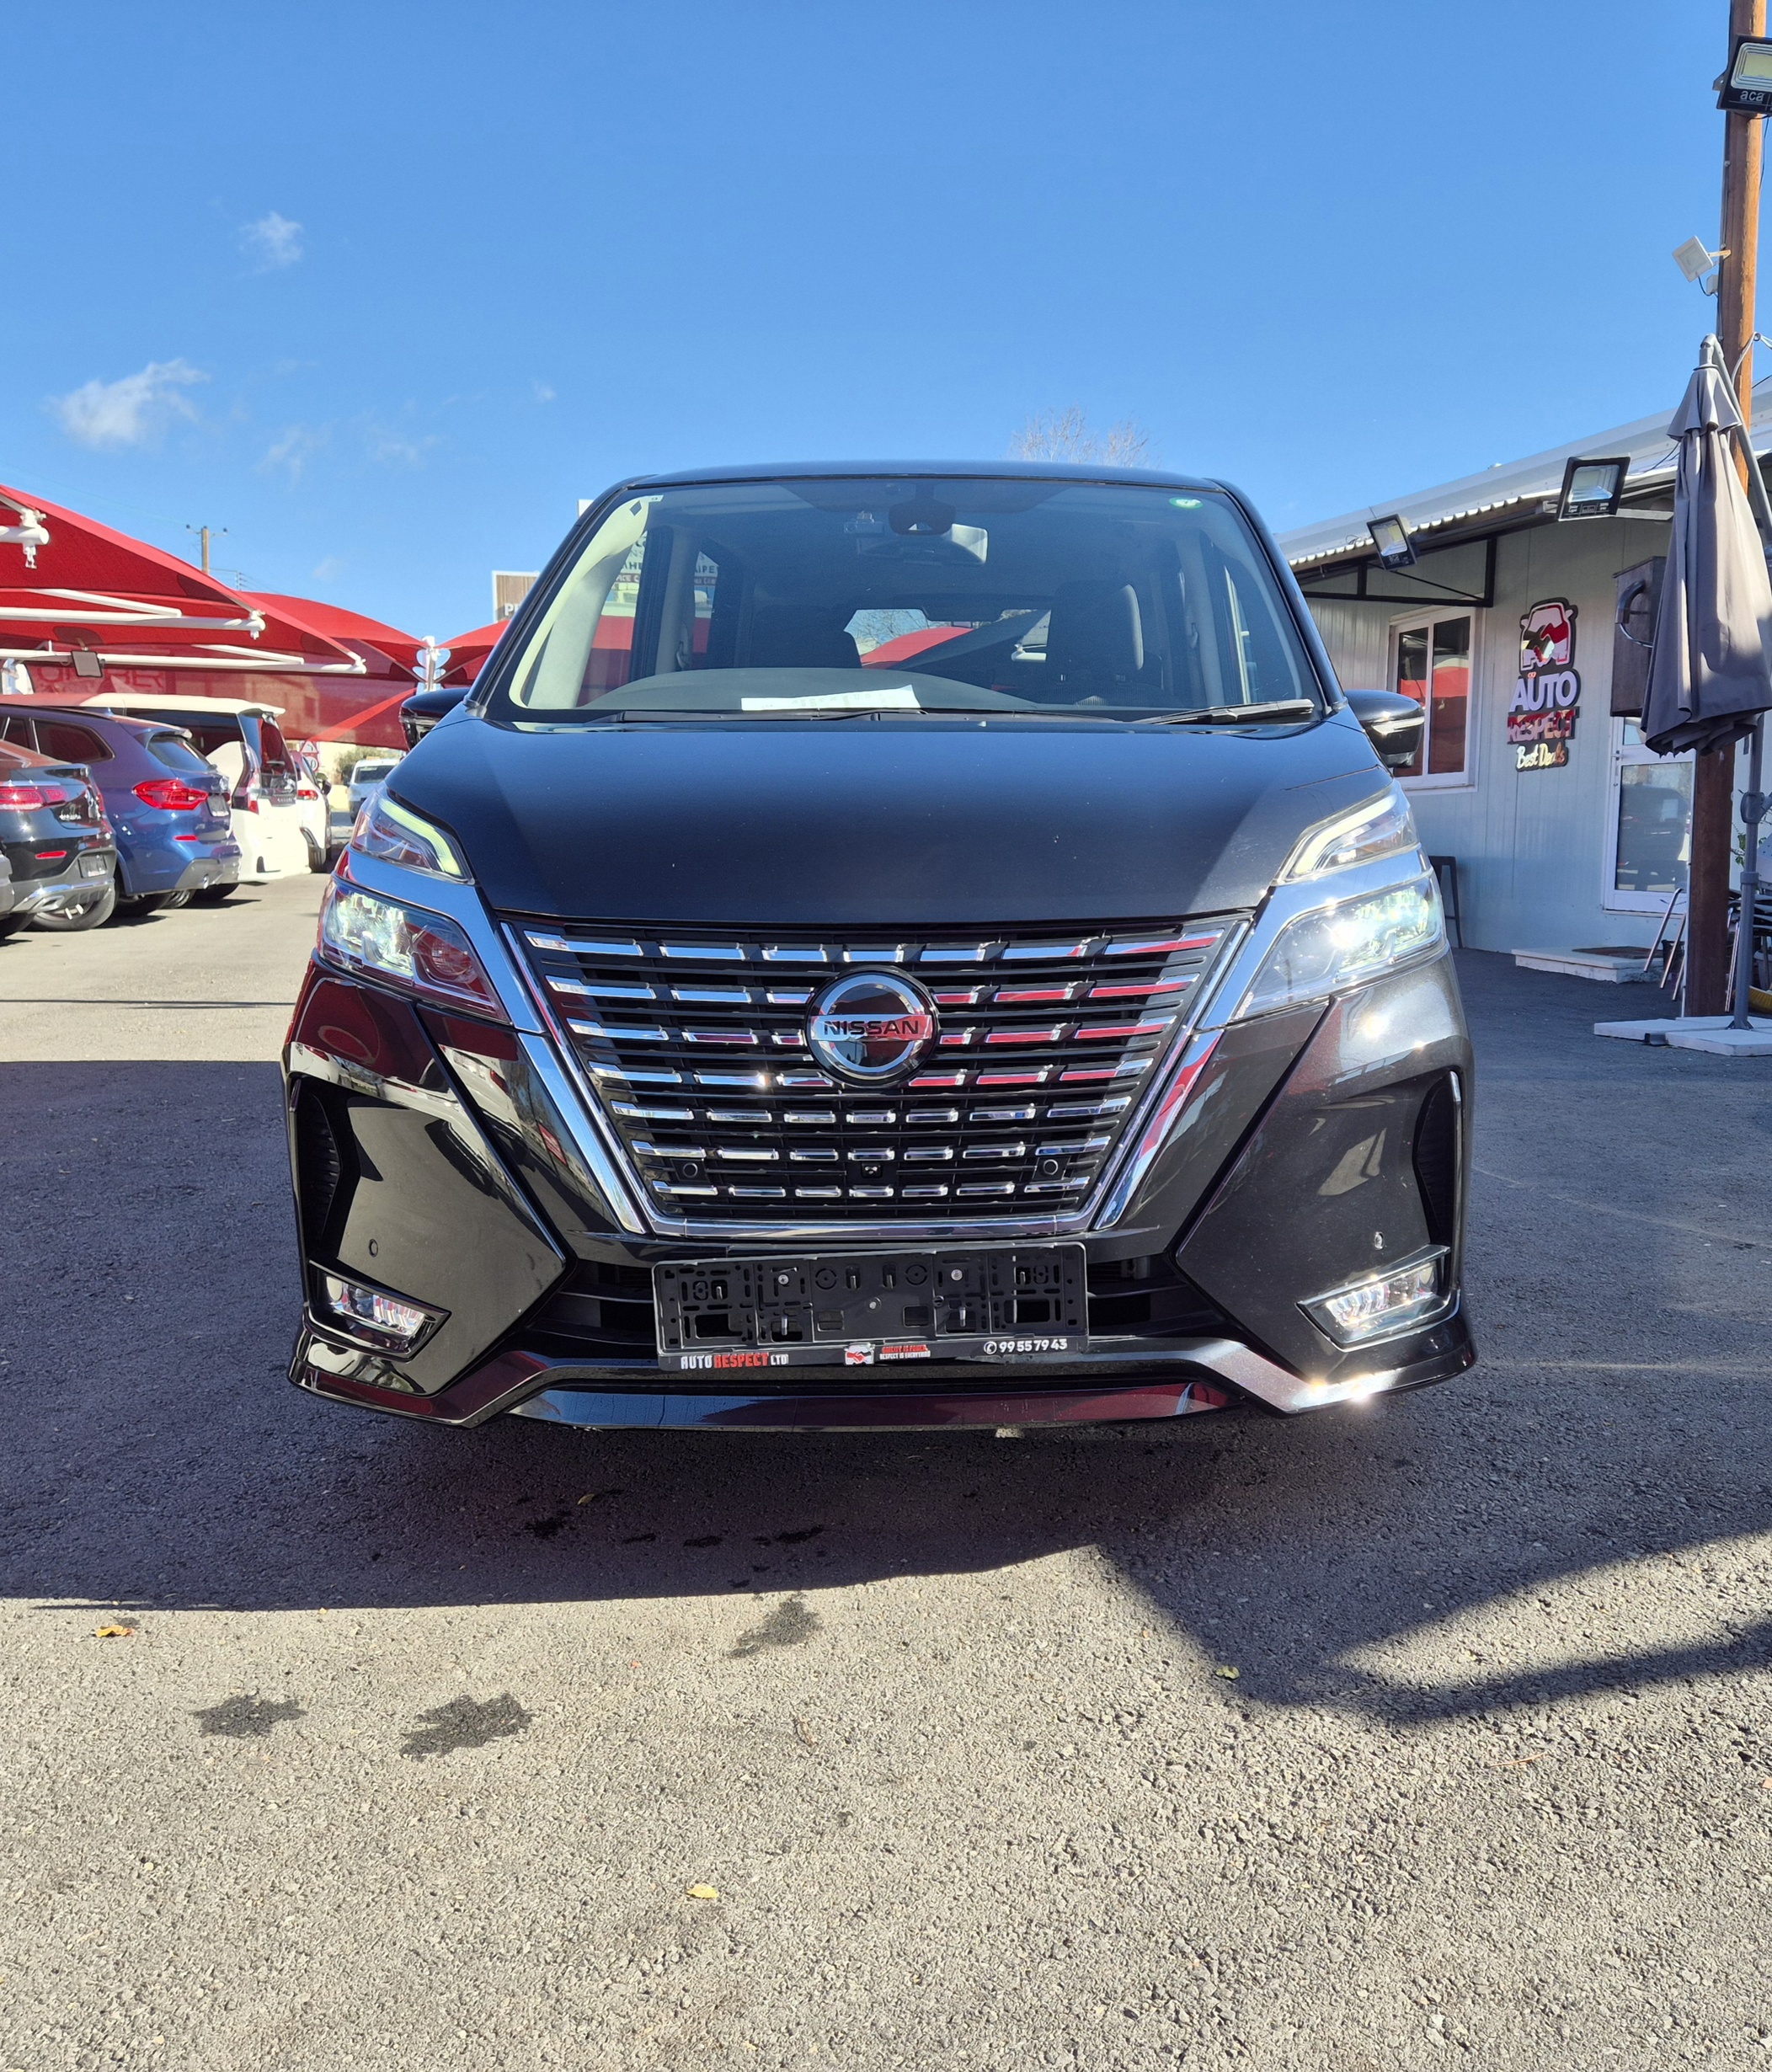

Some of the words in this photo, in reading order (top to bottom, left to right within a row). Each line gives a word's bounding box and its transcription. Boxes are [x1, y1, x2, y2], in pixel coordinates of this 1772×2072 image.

[1740, 90, 1765, 102] aca
[1509, 670, 1577, 712] AUTO
[1508, 709, 1576, 741] RESPECT
[1517, 744, 1539, 769] Best
[1540, 741, 1566, 766] Deals
[824, 1020, 919, 1035] NISSAN
[681, 1354, 713, 1370] AUTO
[713, 1351, 769, 1369] RESPECT
[770, 1354, 789, 1365] LTD
